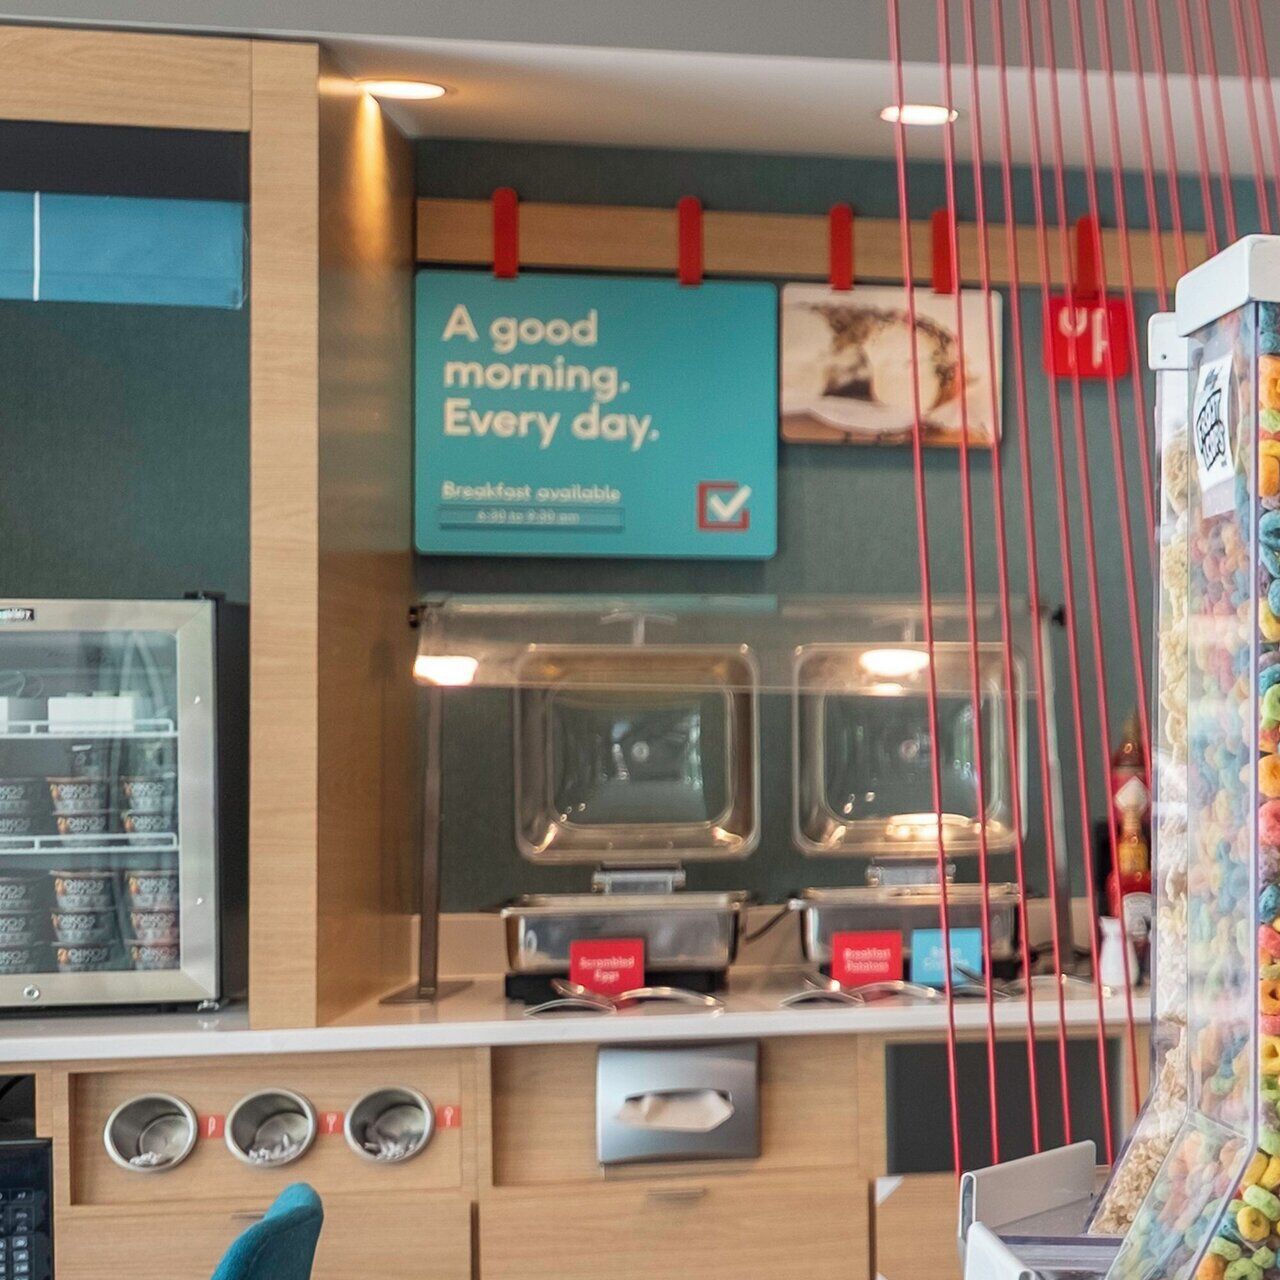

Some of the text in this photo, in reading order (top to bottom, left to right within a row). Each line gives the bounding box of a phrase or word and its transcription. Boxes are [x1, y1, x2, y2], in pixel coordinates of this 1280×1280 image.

[442, 303, 598, 354] A good
[444, 354, 631, 404] morning.
[444, 398, 660, 452] Every day.
[442, 480, 621, 504] Breakfast available
[580, 956, 635, 970] Scrambled
